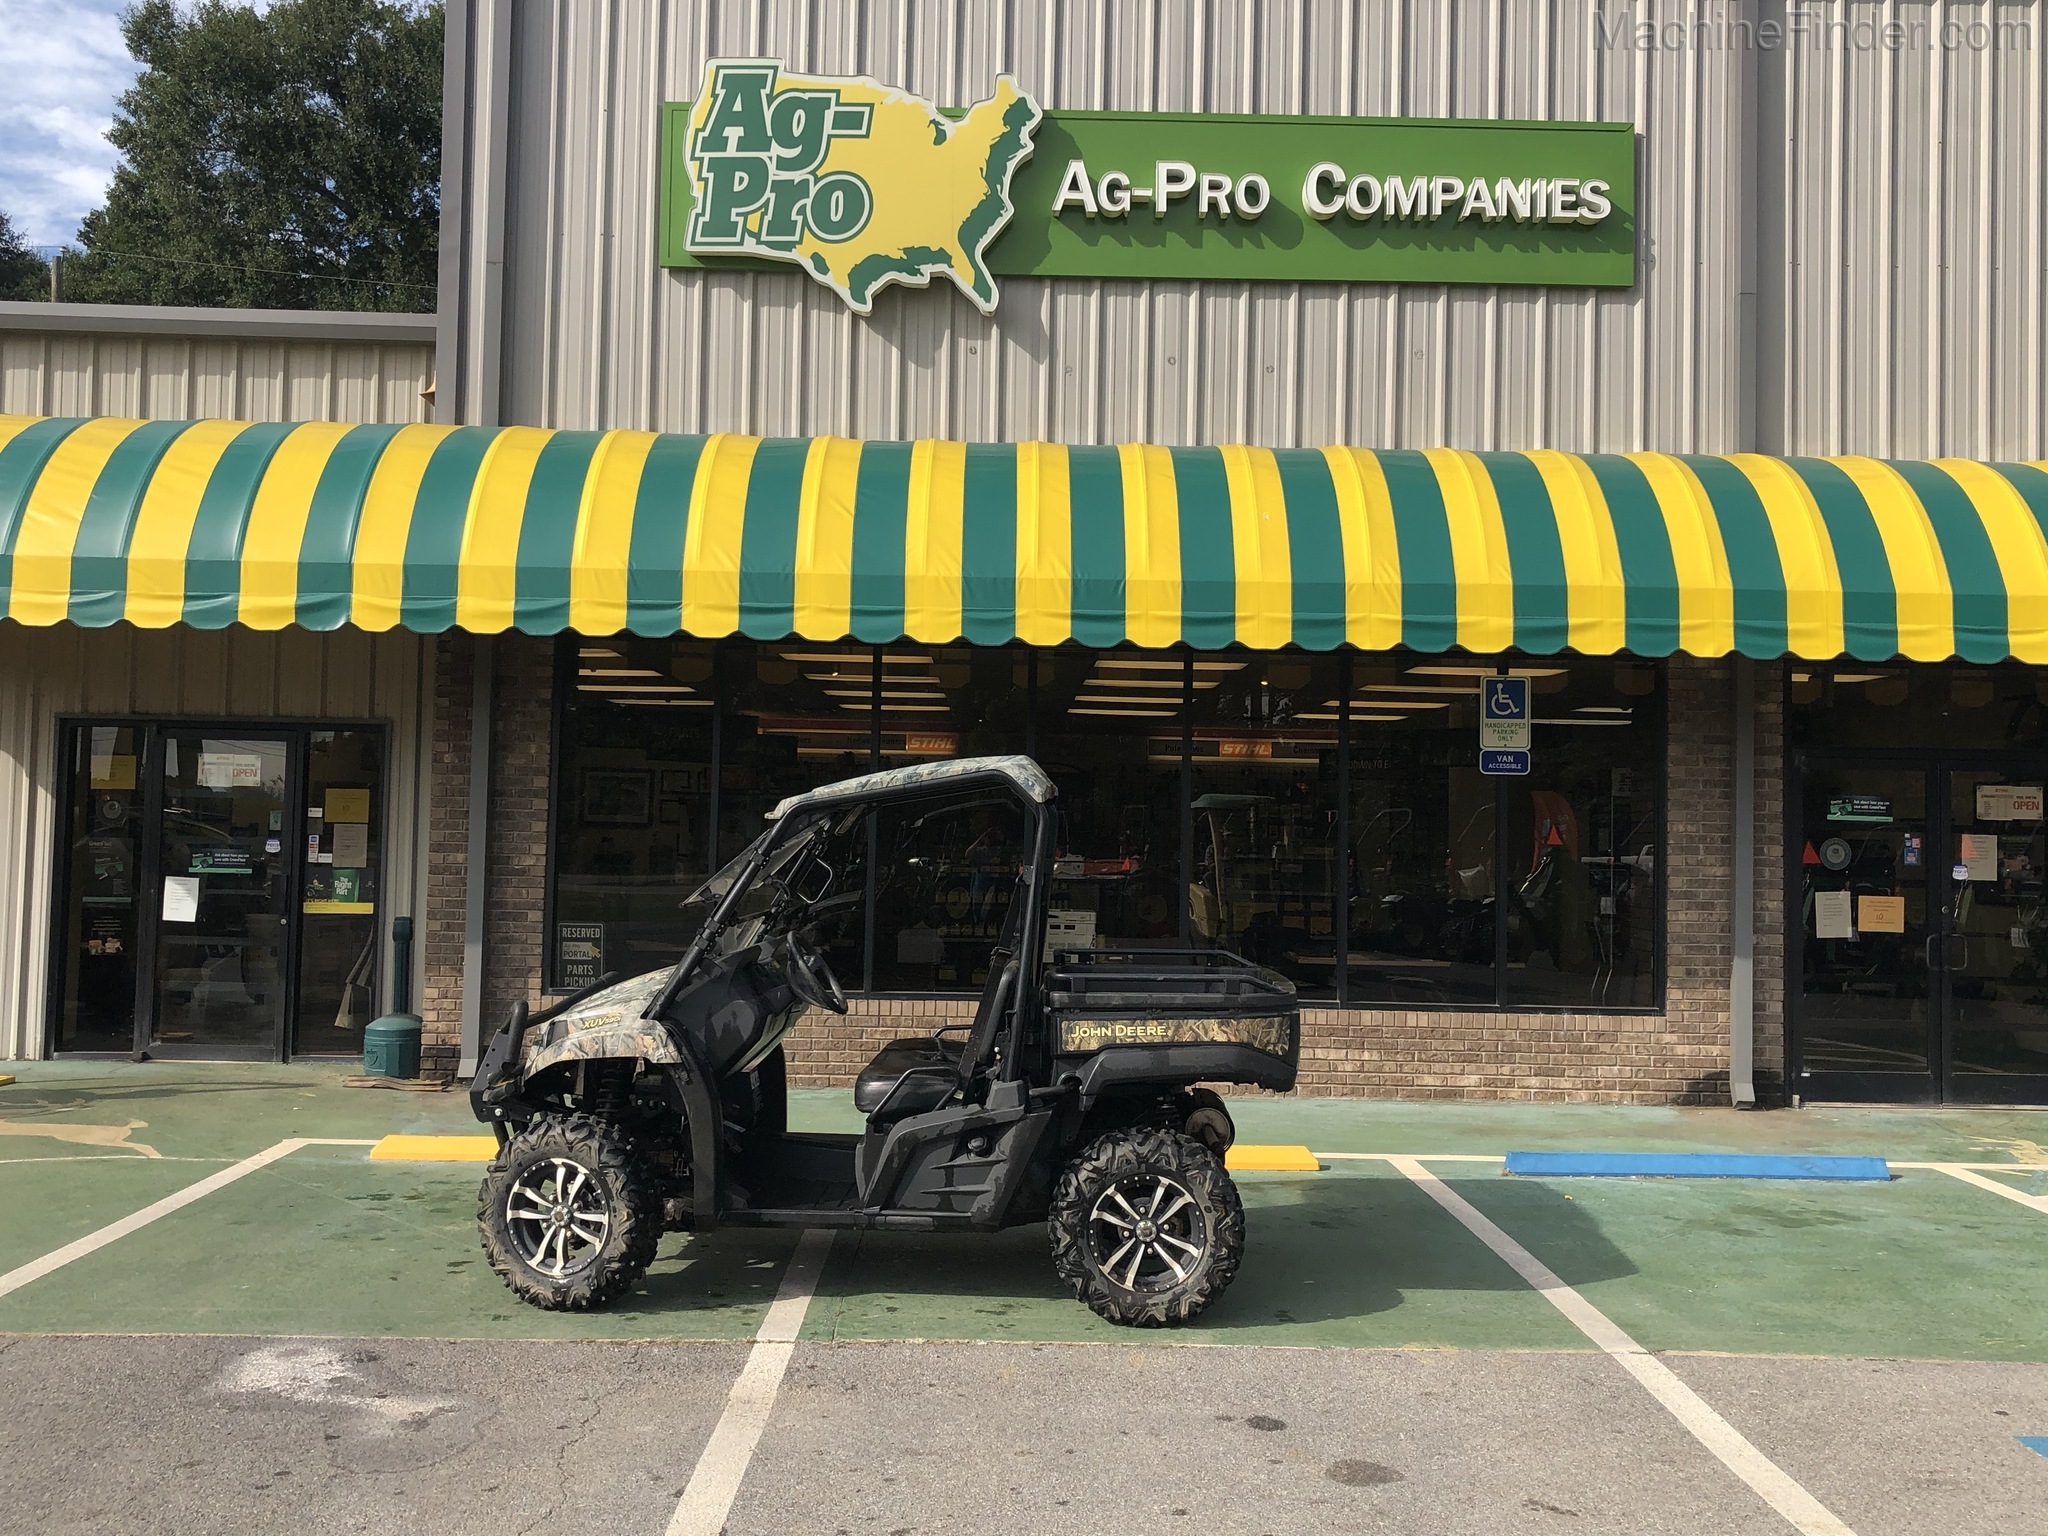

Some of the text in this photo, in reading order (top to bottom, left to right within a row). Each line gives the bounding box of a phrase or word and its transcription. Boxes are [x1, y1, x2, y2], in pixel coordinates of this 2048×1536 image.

[691, 152, 872, 243] Pro
[1302, 161, 1611, 224] COMPANIES
[909, 736, 957, 748] STIHL
[1222, 743, 1270, 755] STIHL
[1497, 755, 1514, 763] VAN
[233, 768, 257, 777] OPEN
[2013, 800, 2040, 811] OPEN
[334, 880, 352, 889] Right
[562, 927, 601, 938] RESERVED
[563, 950, 592, 958] PORTAL
[567, 964, 594, 975] PARTS
[1071, 1024, 1167, 1037] JOHN DEERE
